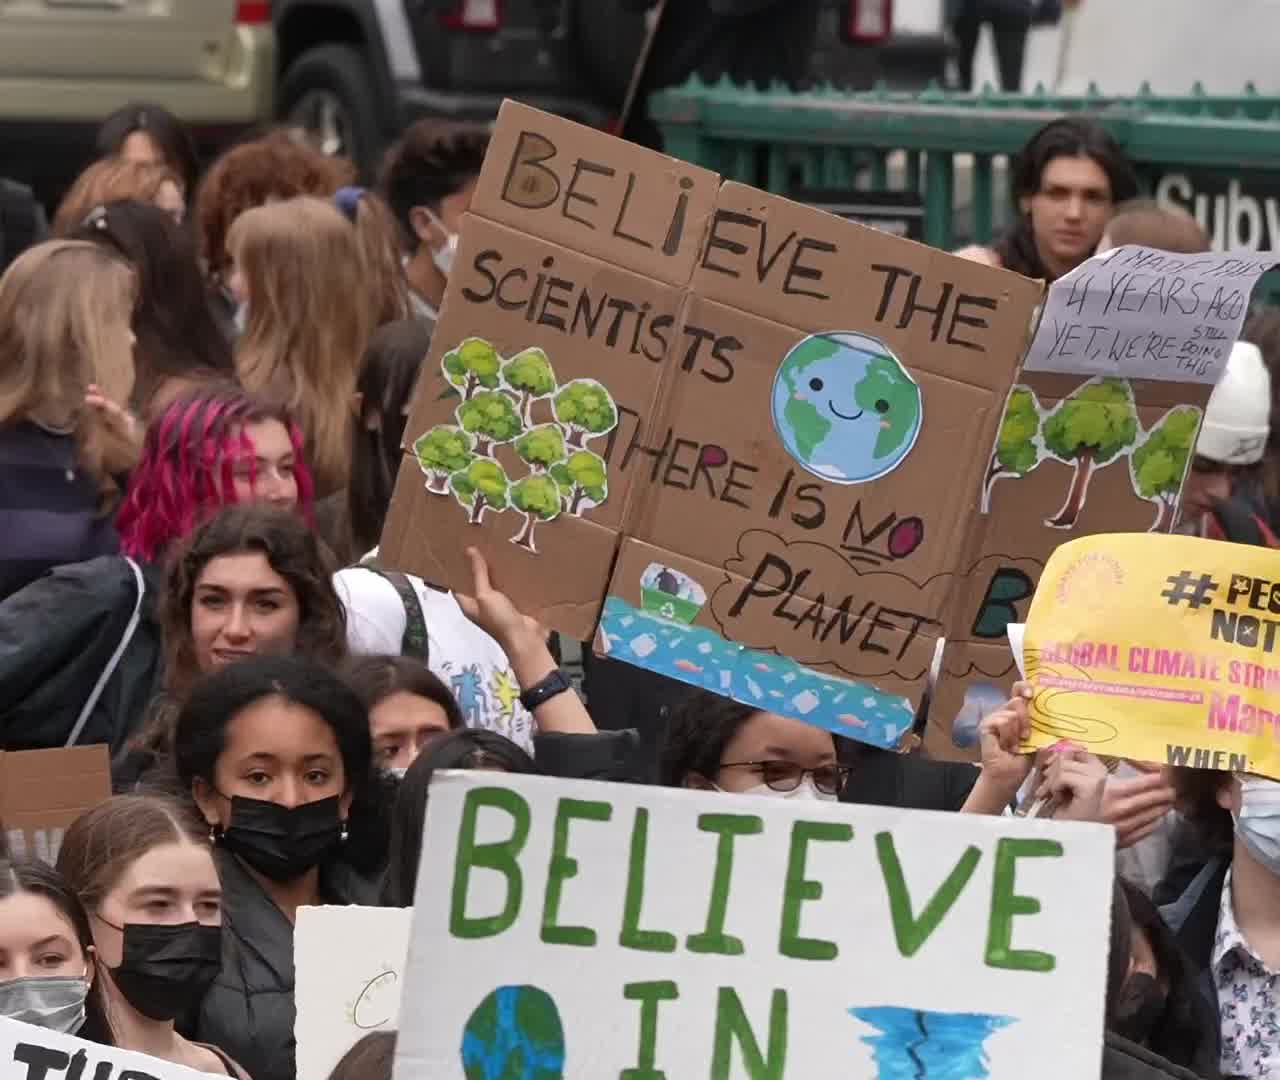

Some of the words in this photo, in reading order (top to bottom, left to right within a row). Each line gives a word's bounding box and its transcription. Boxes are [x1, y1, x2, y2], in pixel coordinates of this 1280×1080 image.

[871, 263, 999, 352] THE
[1065, 272, 1095, 316] 4
[1102, 271, 1205, 317] YEARS
[1203, 286, 1245, 321] AGO
[604, 404, 760, 510] THERE
[767, 468, 827, 530] IS
[842, 499, 925, 560] NO
[727, 551, 944, 662] PLANET
[971, 568, 1034, 638] B
[1128, 645, 1221, 683] CLIMATE
[448, 786, 1064, 972] BELIEVE
